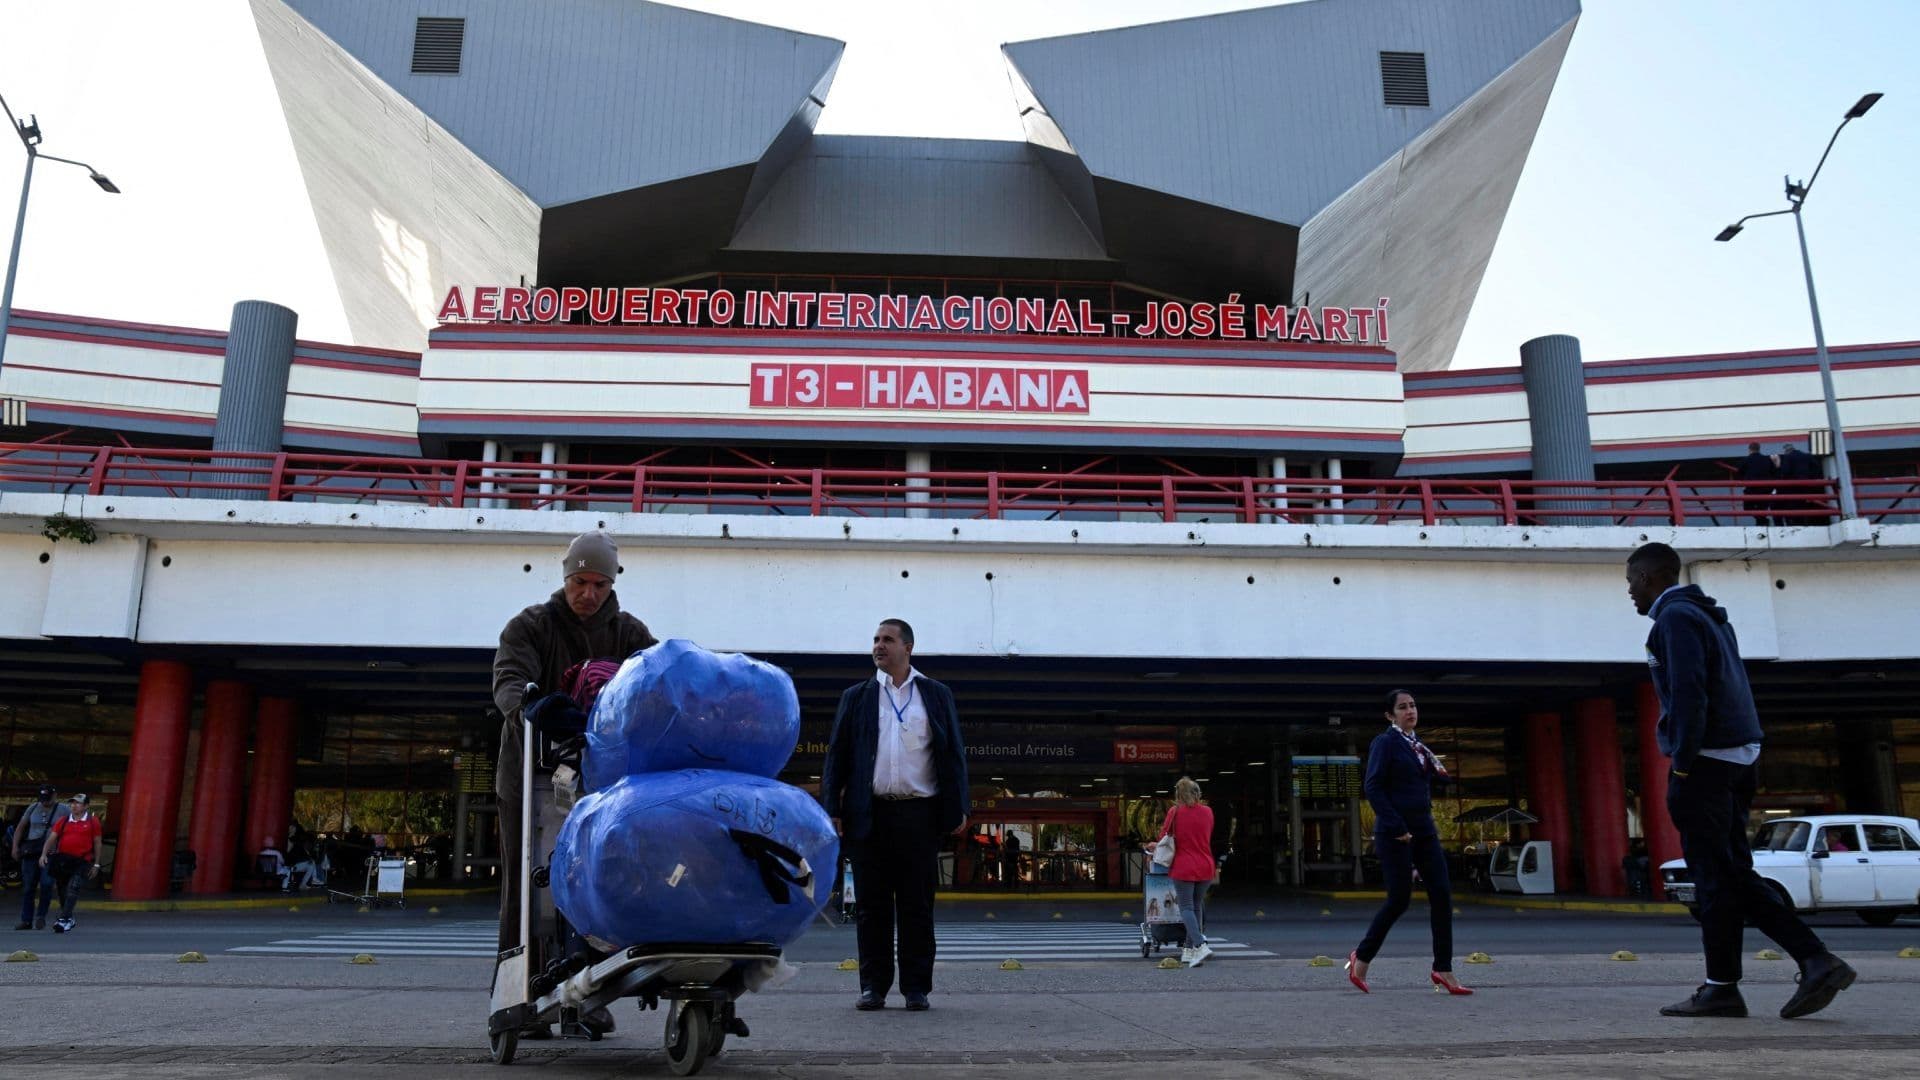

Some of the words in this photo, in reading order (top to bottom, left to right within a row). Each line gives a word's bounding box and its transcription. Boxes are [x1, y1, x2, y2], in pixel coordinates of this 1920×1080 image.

[438, 286, 735, 325] AEROPUERTO
[744, 290, 1105, 334] INTERNACIONAL
[1135, 293, 1246, 338] JOSÉ
[1255, 297, 1390, 343] MARTÍ
[963, 743, 1021, 756] rnational
[1024, 743, 1076, 757] Arrivals
[1117, 743, 1138, 759] T3
